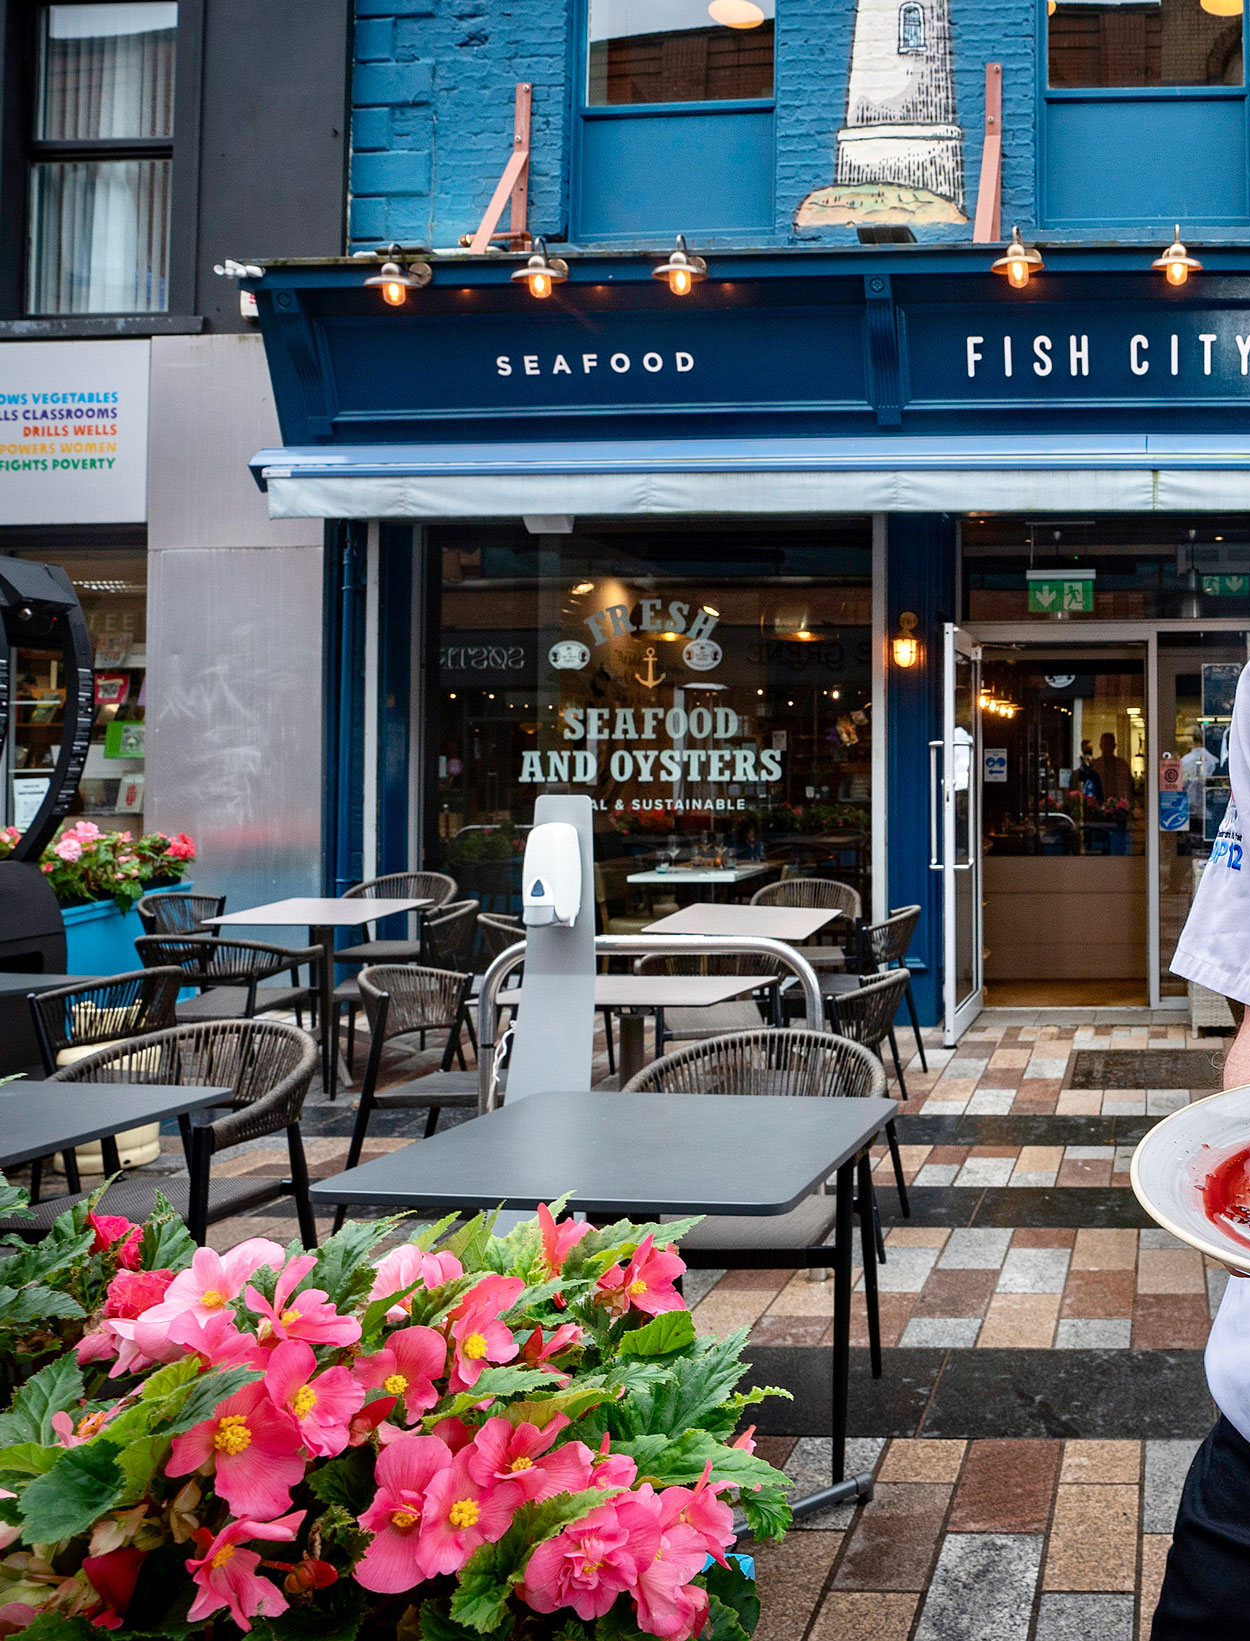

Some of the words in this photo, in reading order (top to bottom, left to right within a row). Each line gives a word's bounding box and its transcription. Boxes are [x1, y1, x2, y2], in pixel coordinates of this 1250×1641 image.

[966, 334, 1089, 377] FISH
[496, 352, 695, 376] SEAFOOD
[32, 392, 118, 404] VEGETABLES
[22, 407, 118, 420] CLASSROOMS
[23, 425, 69, 437] DRILLS
[73, 424, 117, 436] WELLS
[60, 441, 117, 453] WOMEN
[52, 457, 116, 470] POVERTY
[583, 599, 719, 646] FRESH
[563, 706, 739, 740] SEAFOOD
[519, 750, 597, 783] AND
[610, 748, 783, 782] OYSTERS
[614, 799, 625, 811] &
[631, 798, 746, 811] SUSTAINABLE
